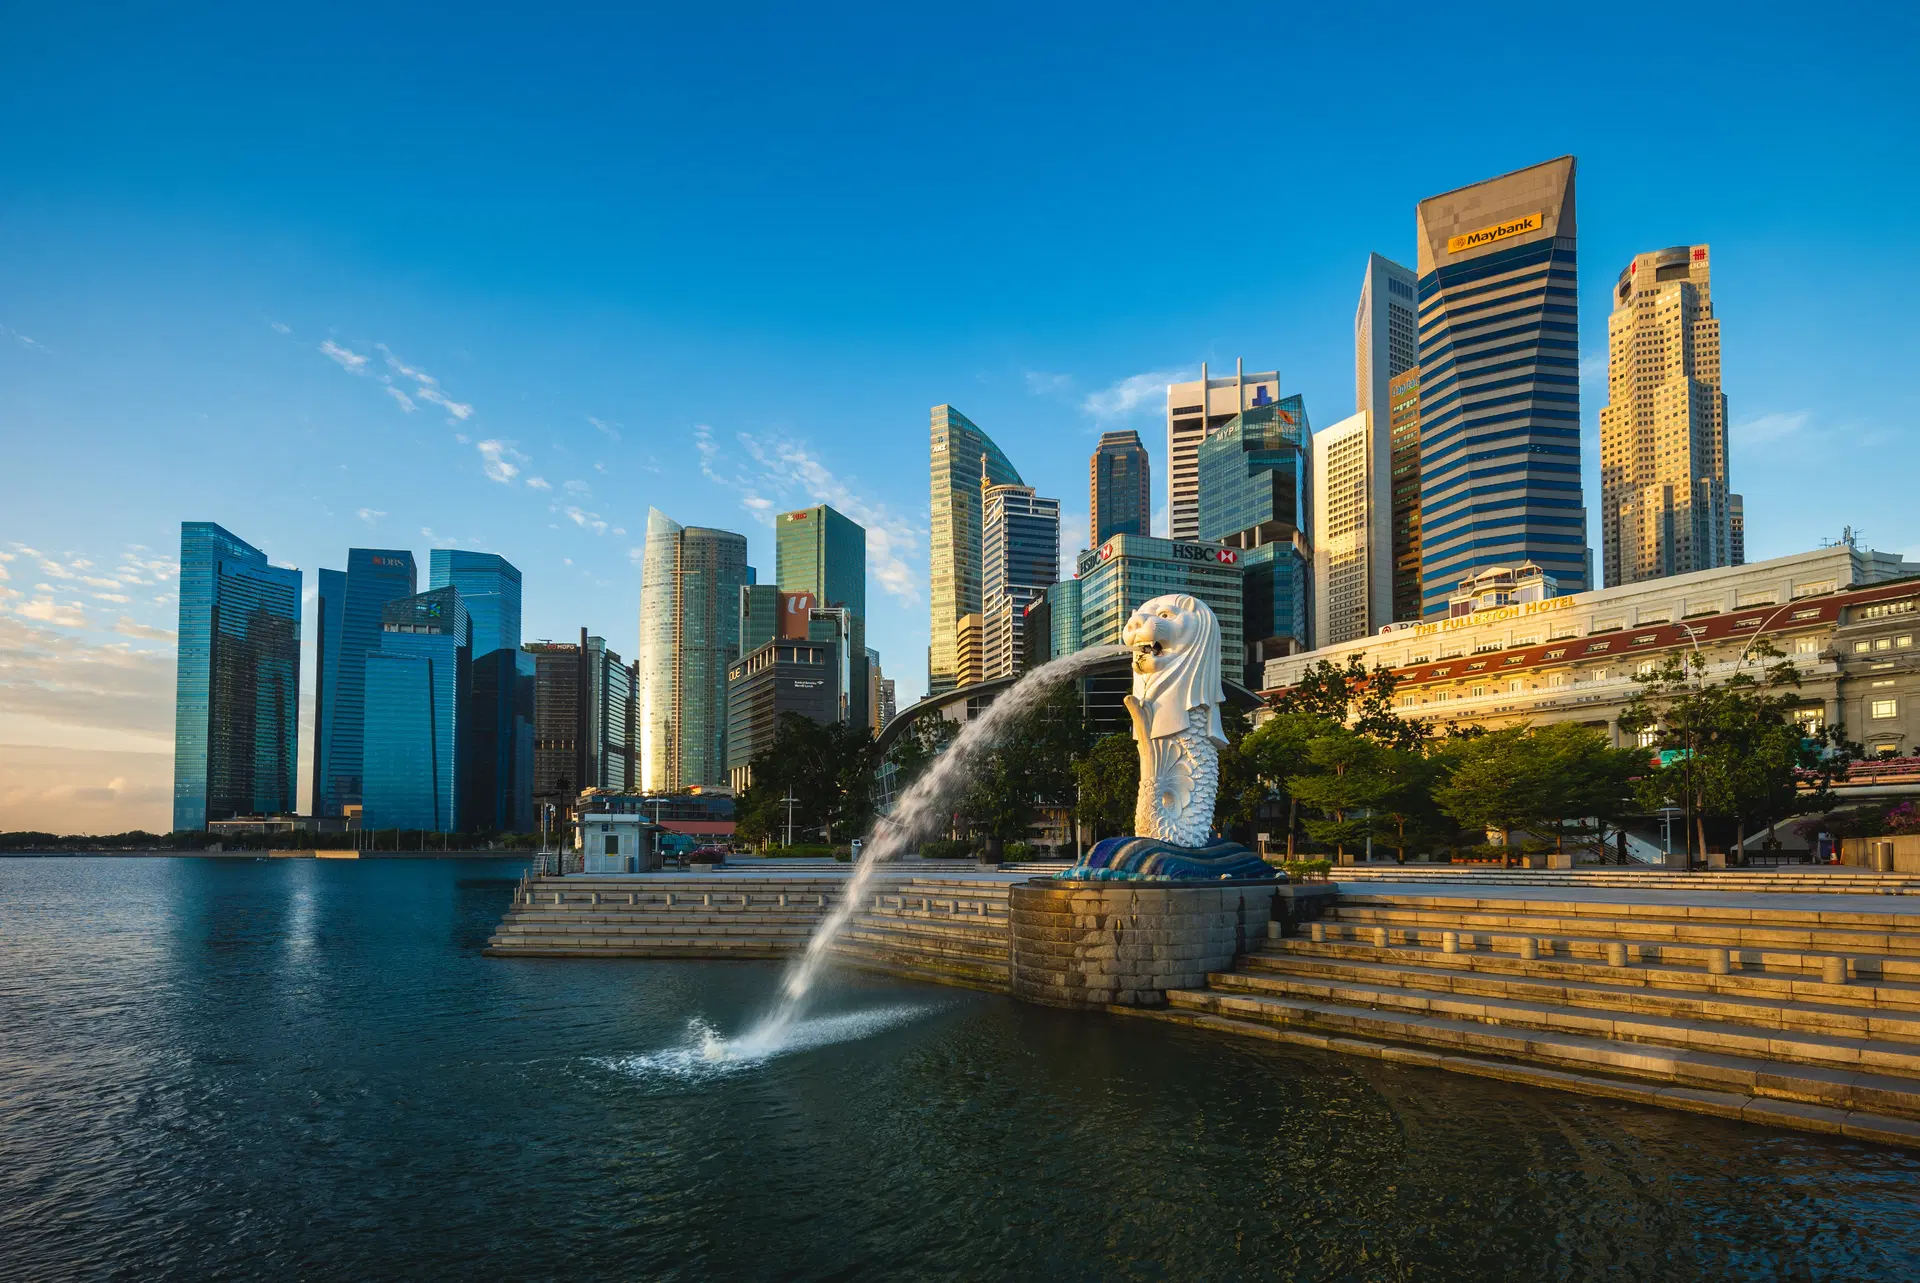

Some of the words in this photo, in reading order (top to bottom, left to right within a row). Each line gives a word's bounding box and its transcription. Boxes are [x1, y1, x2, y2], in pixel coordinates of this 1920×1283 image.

[1467, 219, 1532, 245] Maybank
[1690, 261, 1709, 269] UOB
[1216, 426, 1235, 441] MYP
[383, 557, 404, 567] DBS
[1172, 543, 1216, 562] HSBC
[1080, 550, 1101, 575] HSBC
[1414, 623, 1438, 636] THE
[1442, 606, 1520, 630] FULLERTON
[1525, 595, 1576, 615] HOTEL
